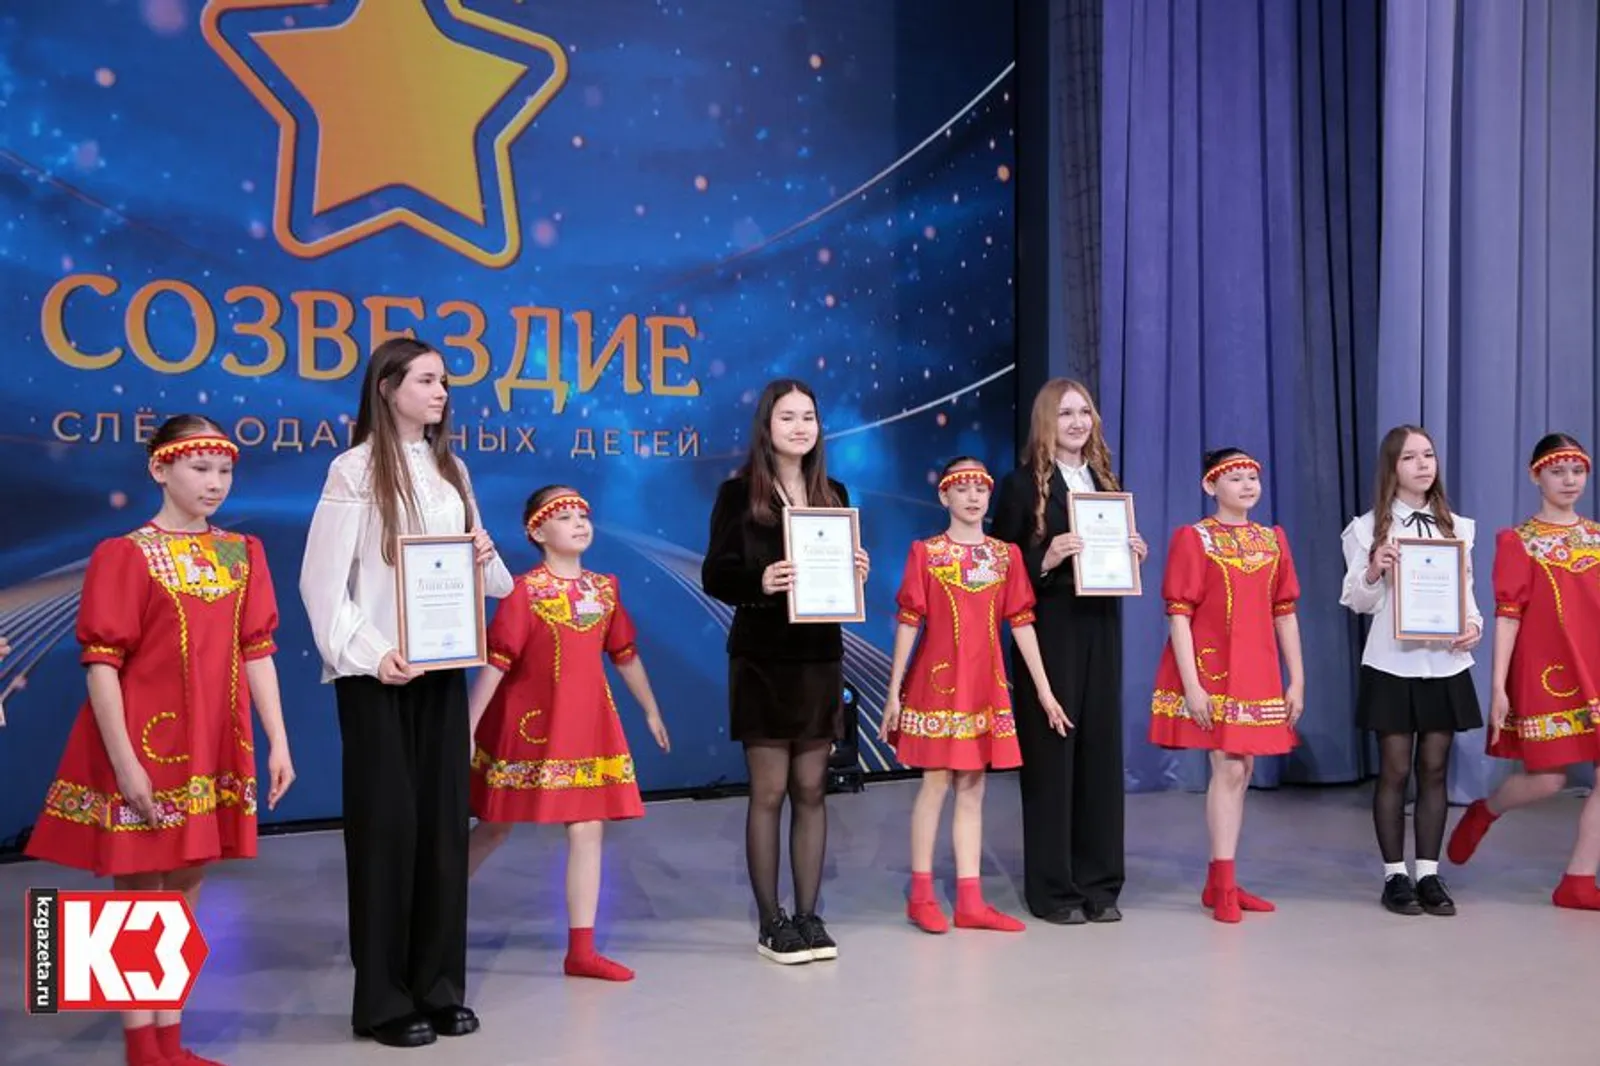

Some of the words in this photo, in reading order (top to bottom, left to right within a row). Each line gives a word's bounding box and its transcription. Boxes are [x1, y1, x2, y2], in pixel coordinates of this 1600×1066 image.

[52, 408, 178, 443] СЛЁ
[235, 416, 535, 453] ОДАНЫХ
[570, 426, 699, 460] ДЕТЕЙ
